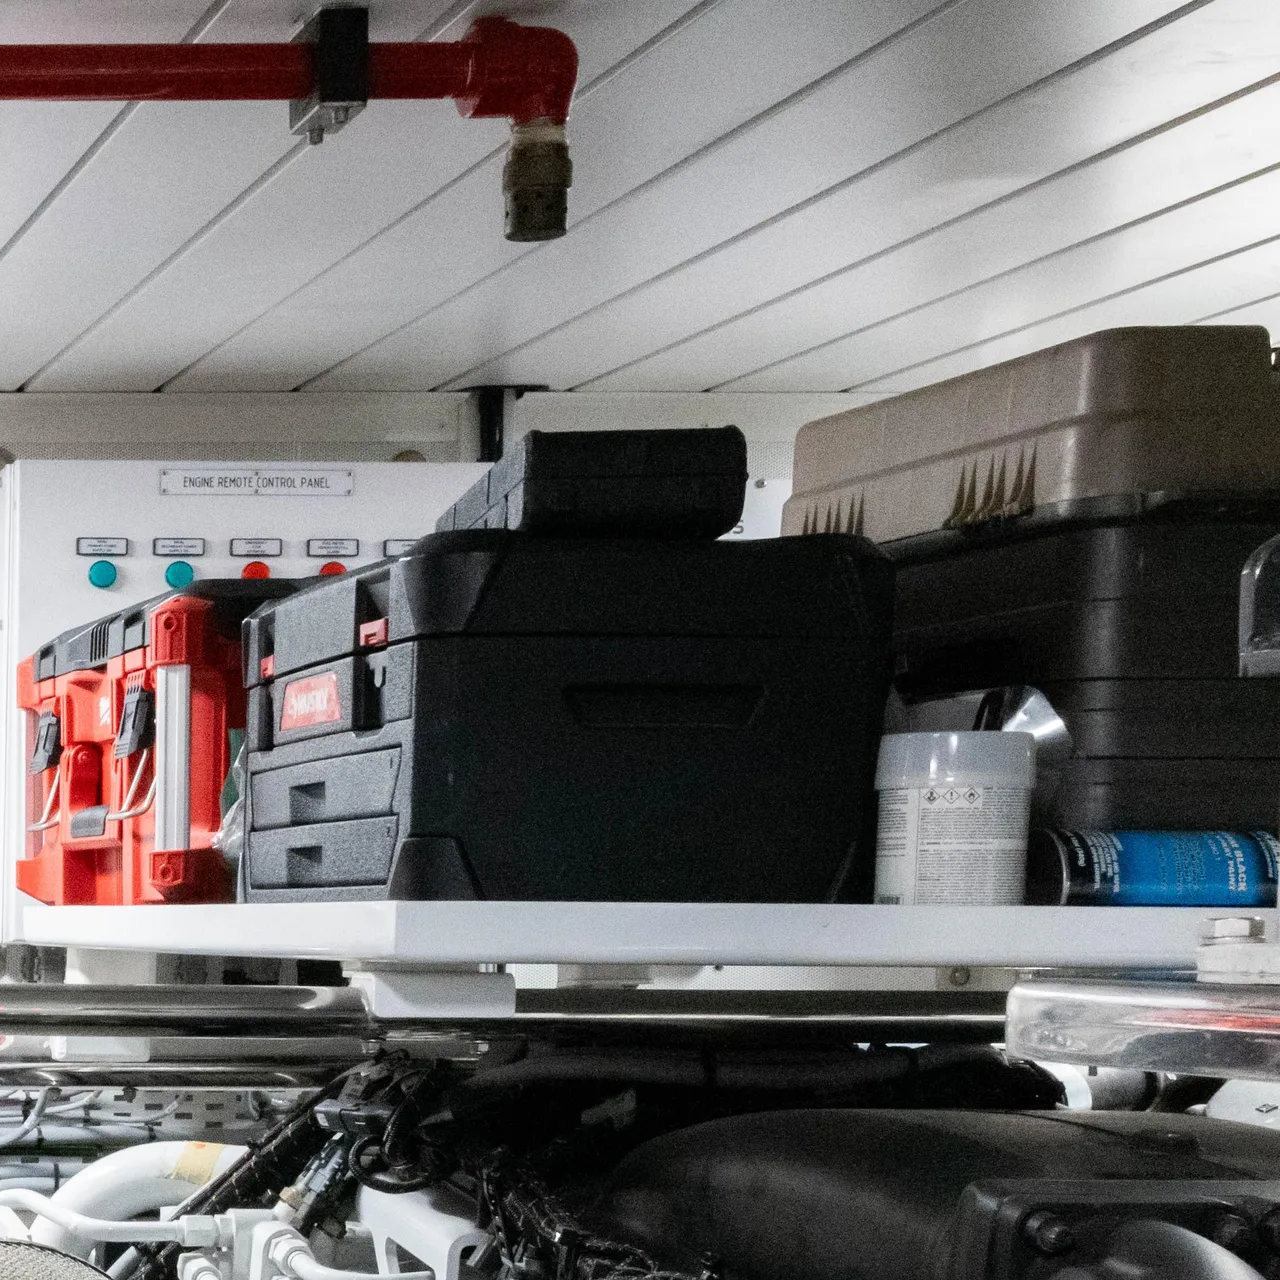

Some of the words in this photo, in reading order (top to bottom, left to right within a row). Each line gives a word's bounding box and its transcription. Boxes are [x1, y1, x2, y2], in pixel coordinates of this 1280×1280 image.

[182, 475, 213, 489] ENGINE
[216, 475, 252, 489] REMOTE
[256, 475, 296, 489] CONTROL
[299, 475, 331, 489] PANEL
[1234, 850, 1247, 892] BLACK
